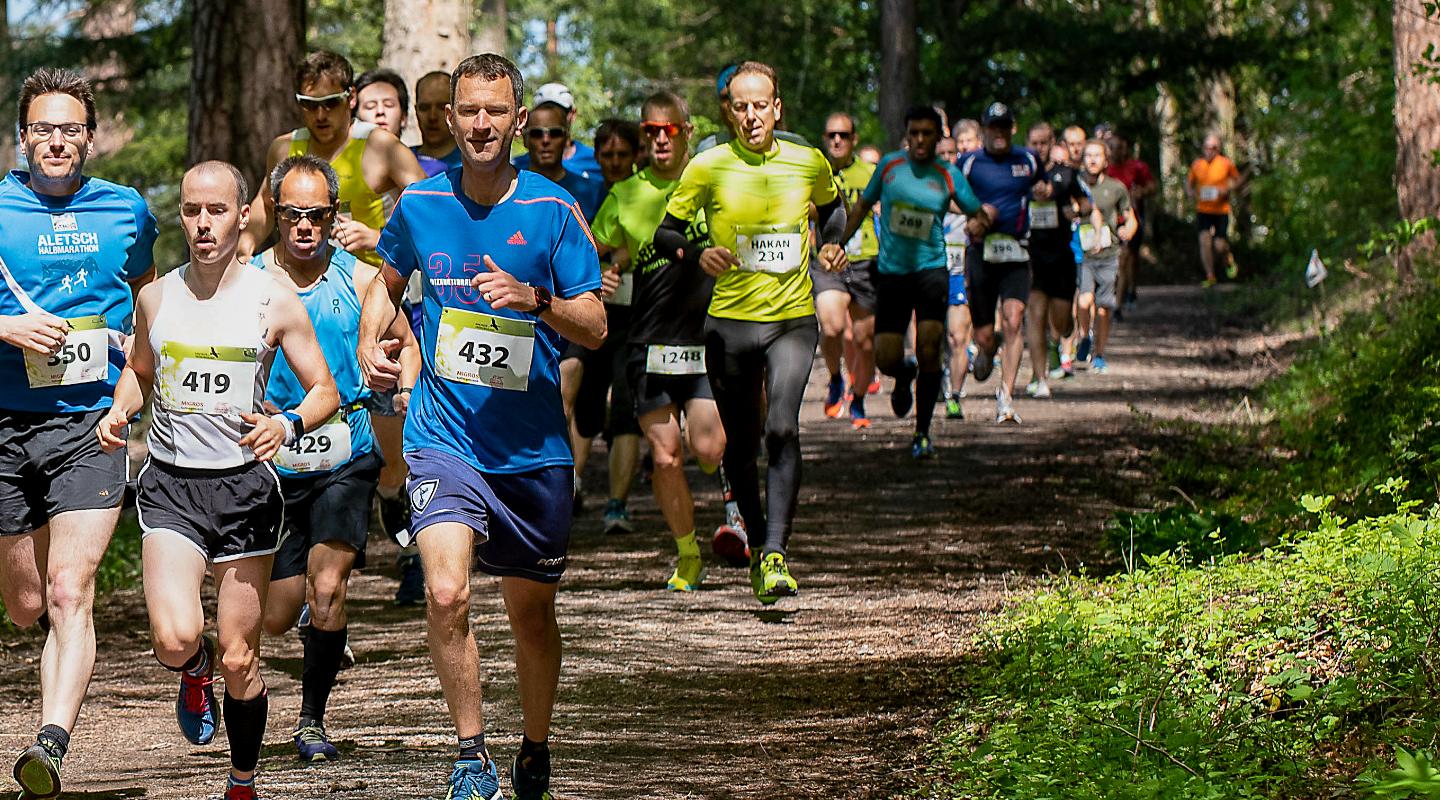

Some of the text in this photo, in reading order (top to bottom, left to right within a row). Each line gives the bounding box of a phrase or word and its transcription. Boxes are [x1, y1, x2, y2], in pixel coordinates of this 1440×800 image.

[38, 232, 99, 247] ALETSCH
[751, 239, 790, 249] HAKAN
[38, 245, 100, 255] HALBMARATHON
[758, 251, 785, 263] 234
[458, 341, 510, 370] 432
[456, 370, 480, 379] MIGROS
[182, 371, 231, 394] 419
[181, 400, 204, 408] MIGROS
[288, 435, 331, 455] 429
